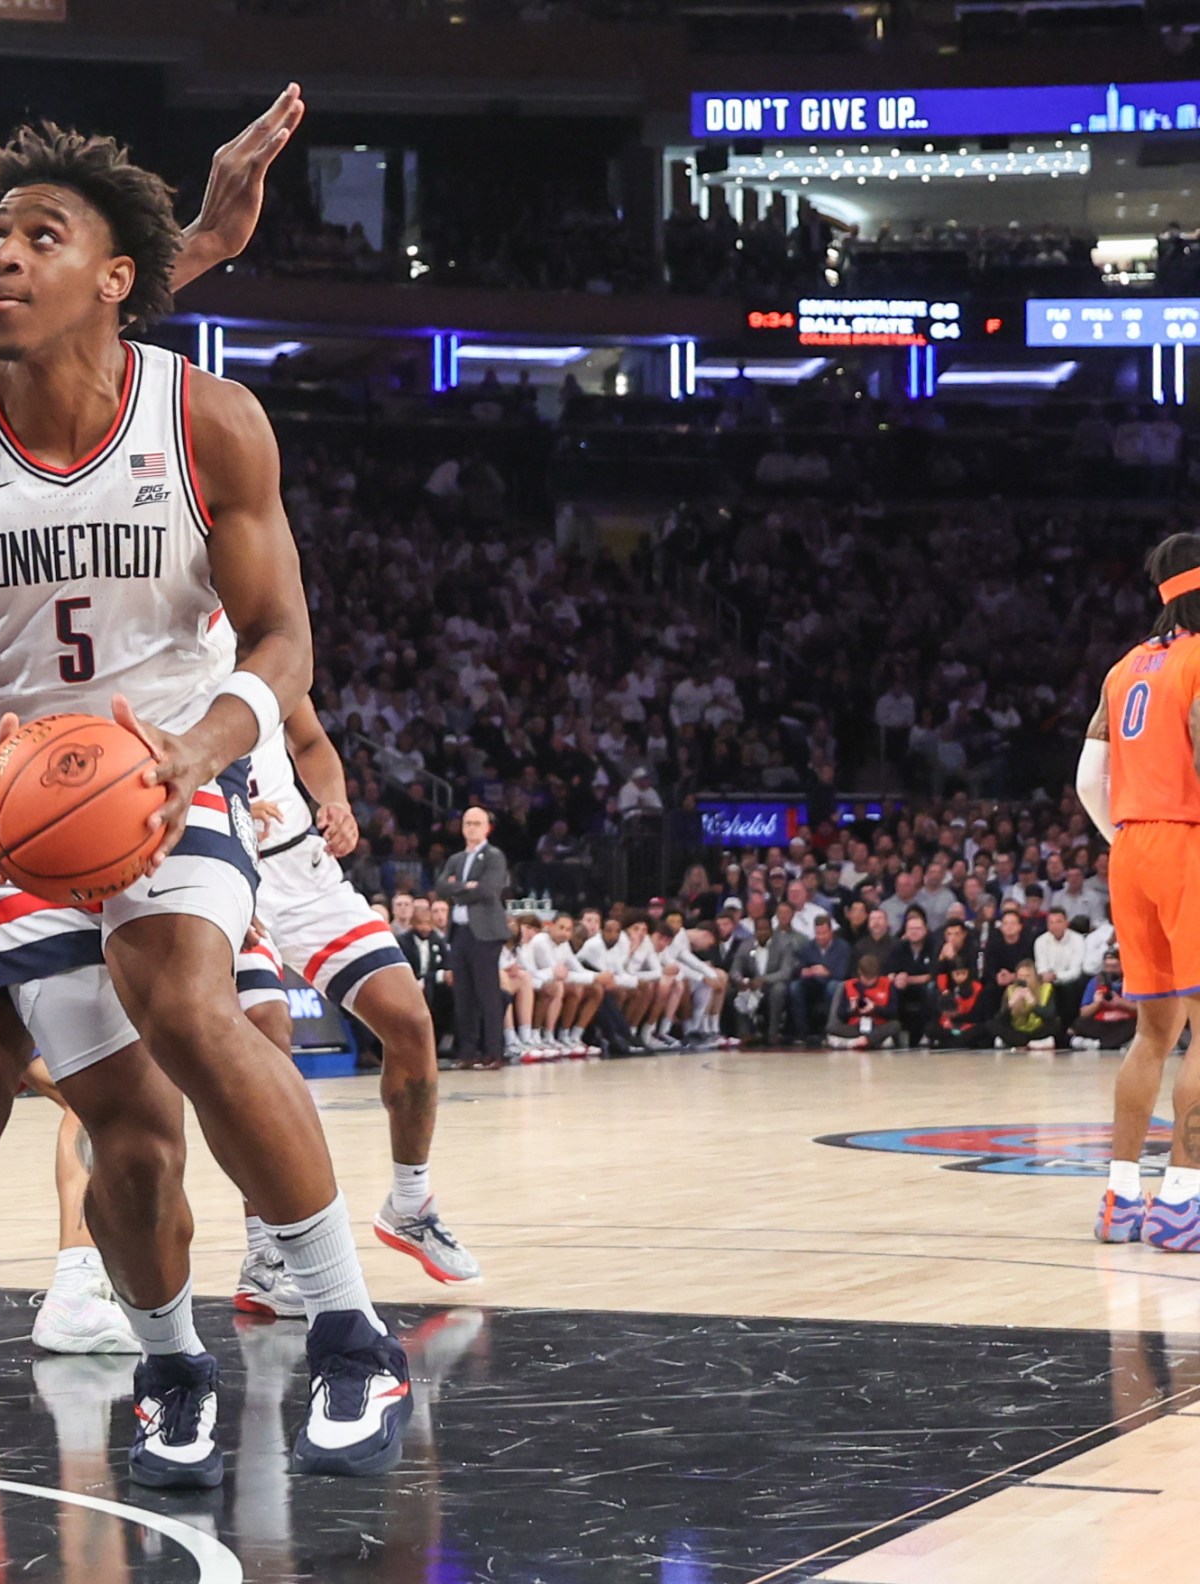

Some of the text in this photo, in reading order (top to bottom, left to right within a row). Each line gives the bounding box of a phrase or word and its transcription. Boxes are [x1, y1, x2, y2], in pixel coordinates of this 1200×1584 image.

[706, 97, 928, 131] DON'T GIVE UP...
[749, 311, 794, 328] 9:34
[800, 317, 961, 339] BALL STATE 64
[1052, 322, 1067, 340] 0
[1092, 322, 1104, 339] 1
[134, 491, 171, 503] EAST
[138, 483, 165, 494] BIG
[55, 596, 95, 683] 5
[1121, 680, 1150, 740] 0
